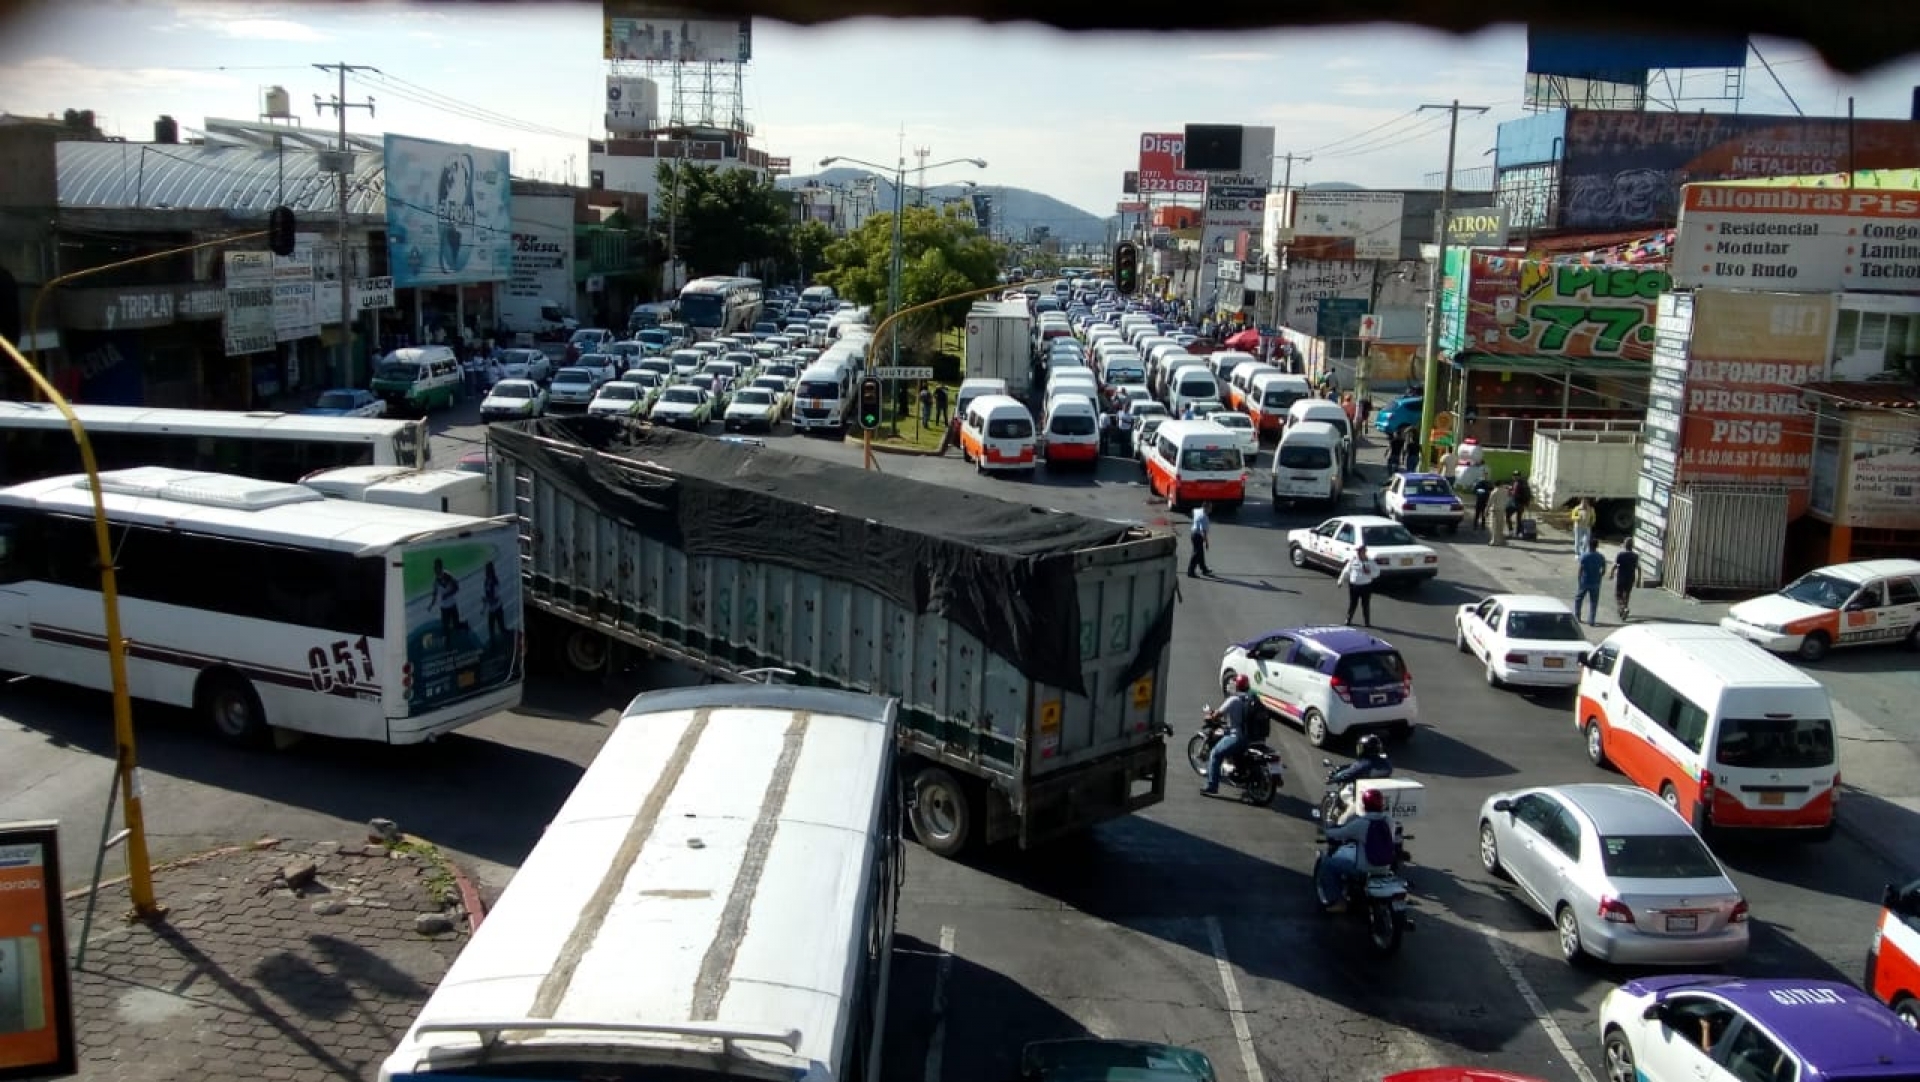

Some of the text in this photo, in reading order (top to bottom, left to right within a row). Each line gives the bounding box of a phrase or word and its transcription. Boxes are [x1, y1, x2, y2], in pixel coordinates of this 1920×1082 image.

[1141, 179, 1203, 191] 3221682
[1209, 199, 1246, 211] HSBC
[1698, 189, 1844, 209] Alfombras
[1719, 222, 1819, 235] Residencial
[1716, 241, 1790, 255] Modular
[1715, 262, 1798, 278] Uso Rudo
[119, 293, 174, 320] TRIPLAY
[1688, 359, 1822, 384] ALFOMBRAS
[1689, 388, 1810, 415] PERSIANAS
[1710, 418, 1782, 444] PISOS
[308, 635, 374, 692] 051
[0, 877, 41, 891] orola
